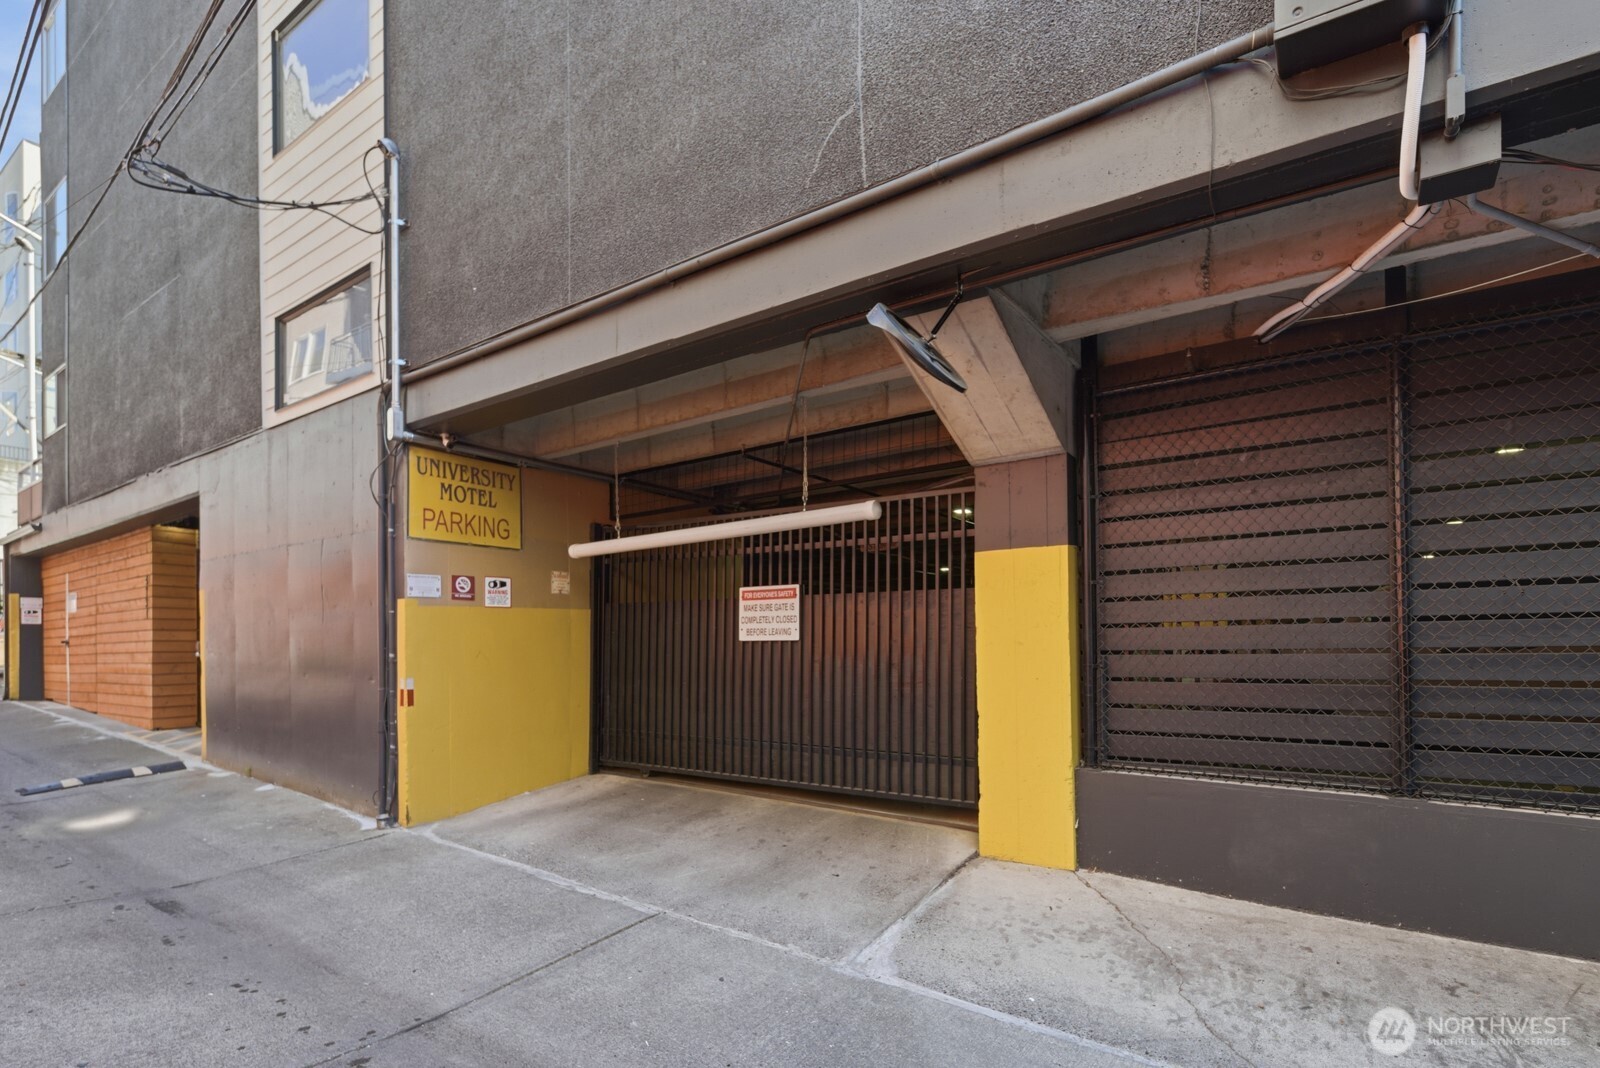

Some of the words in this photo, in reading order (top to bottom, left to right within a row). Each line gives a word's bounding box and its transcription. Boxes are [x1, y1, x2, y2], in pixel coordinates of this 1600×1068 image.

[416, 456, 516, 491] UNIVERSITY
[440, 482, 498, 508] MOTEL
[423, 508, 511, 540] PARKING
[778, 590, 794, 598] SAFETY
[744, 604, 758, 612] MAKE
[759, 603, 773, 611] SURE
[774, 603, 789, 611] GATE
[790, 603, 795, 611] IS
[741, 615, 775, 624] COMPLETELY
[775, 615, 798, 623] CLOSED
[746, 628, 768, 636] BEFORE
[768, 627, 792, 636] LEAVING
